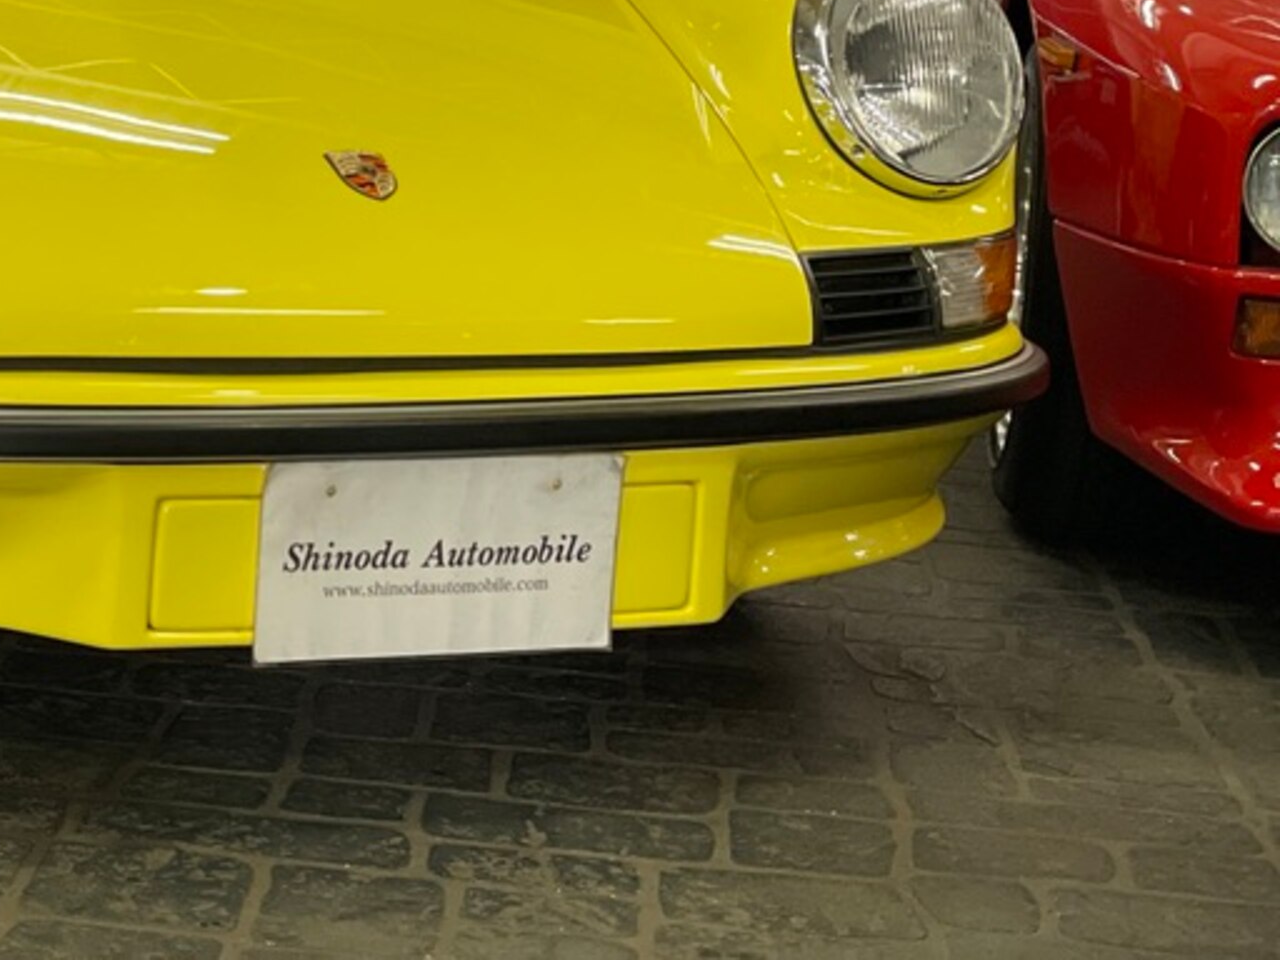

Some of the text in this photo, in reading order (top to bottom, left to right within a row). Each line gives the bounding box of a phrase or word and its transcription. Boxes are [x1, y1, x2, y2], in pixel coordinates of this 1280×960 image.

[283, 534, 592, 573] Shinoda Automobile
[322, 577, 549, 597] www.shinodaautomobile.com
